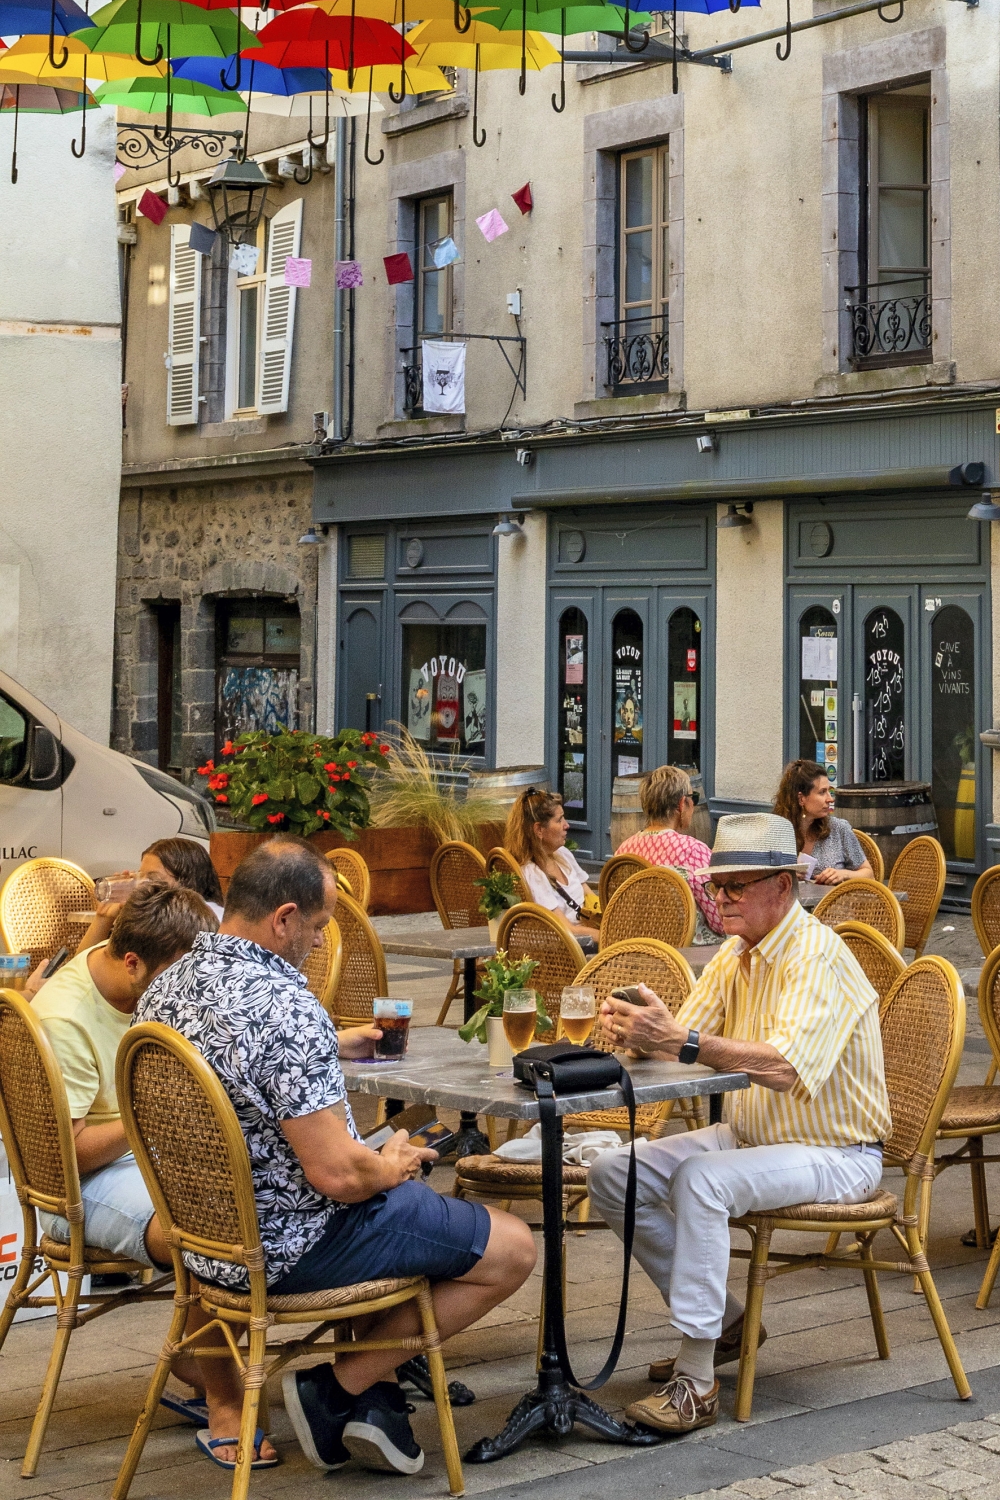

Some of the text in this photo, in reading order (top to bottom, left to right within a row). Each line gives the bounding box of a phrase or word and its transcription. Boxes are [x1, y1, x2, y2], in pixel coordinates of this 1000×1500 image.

[616, 645, 640, 660] VOYOU
[940, 641, 961, 653] CAVE
[870, 649, 900, 664] VOYOU
[947, 654, 953, 667] À
[421, 655, 466, 683] VOYOU
